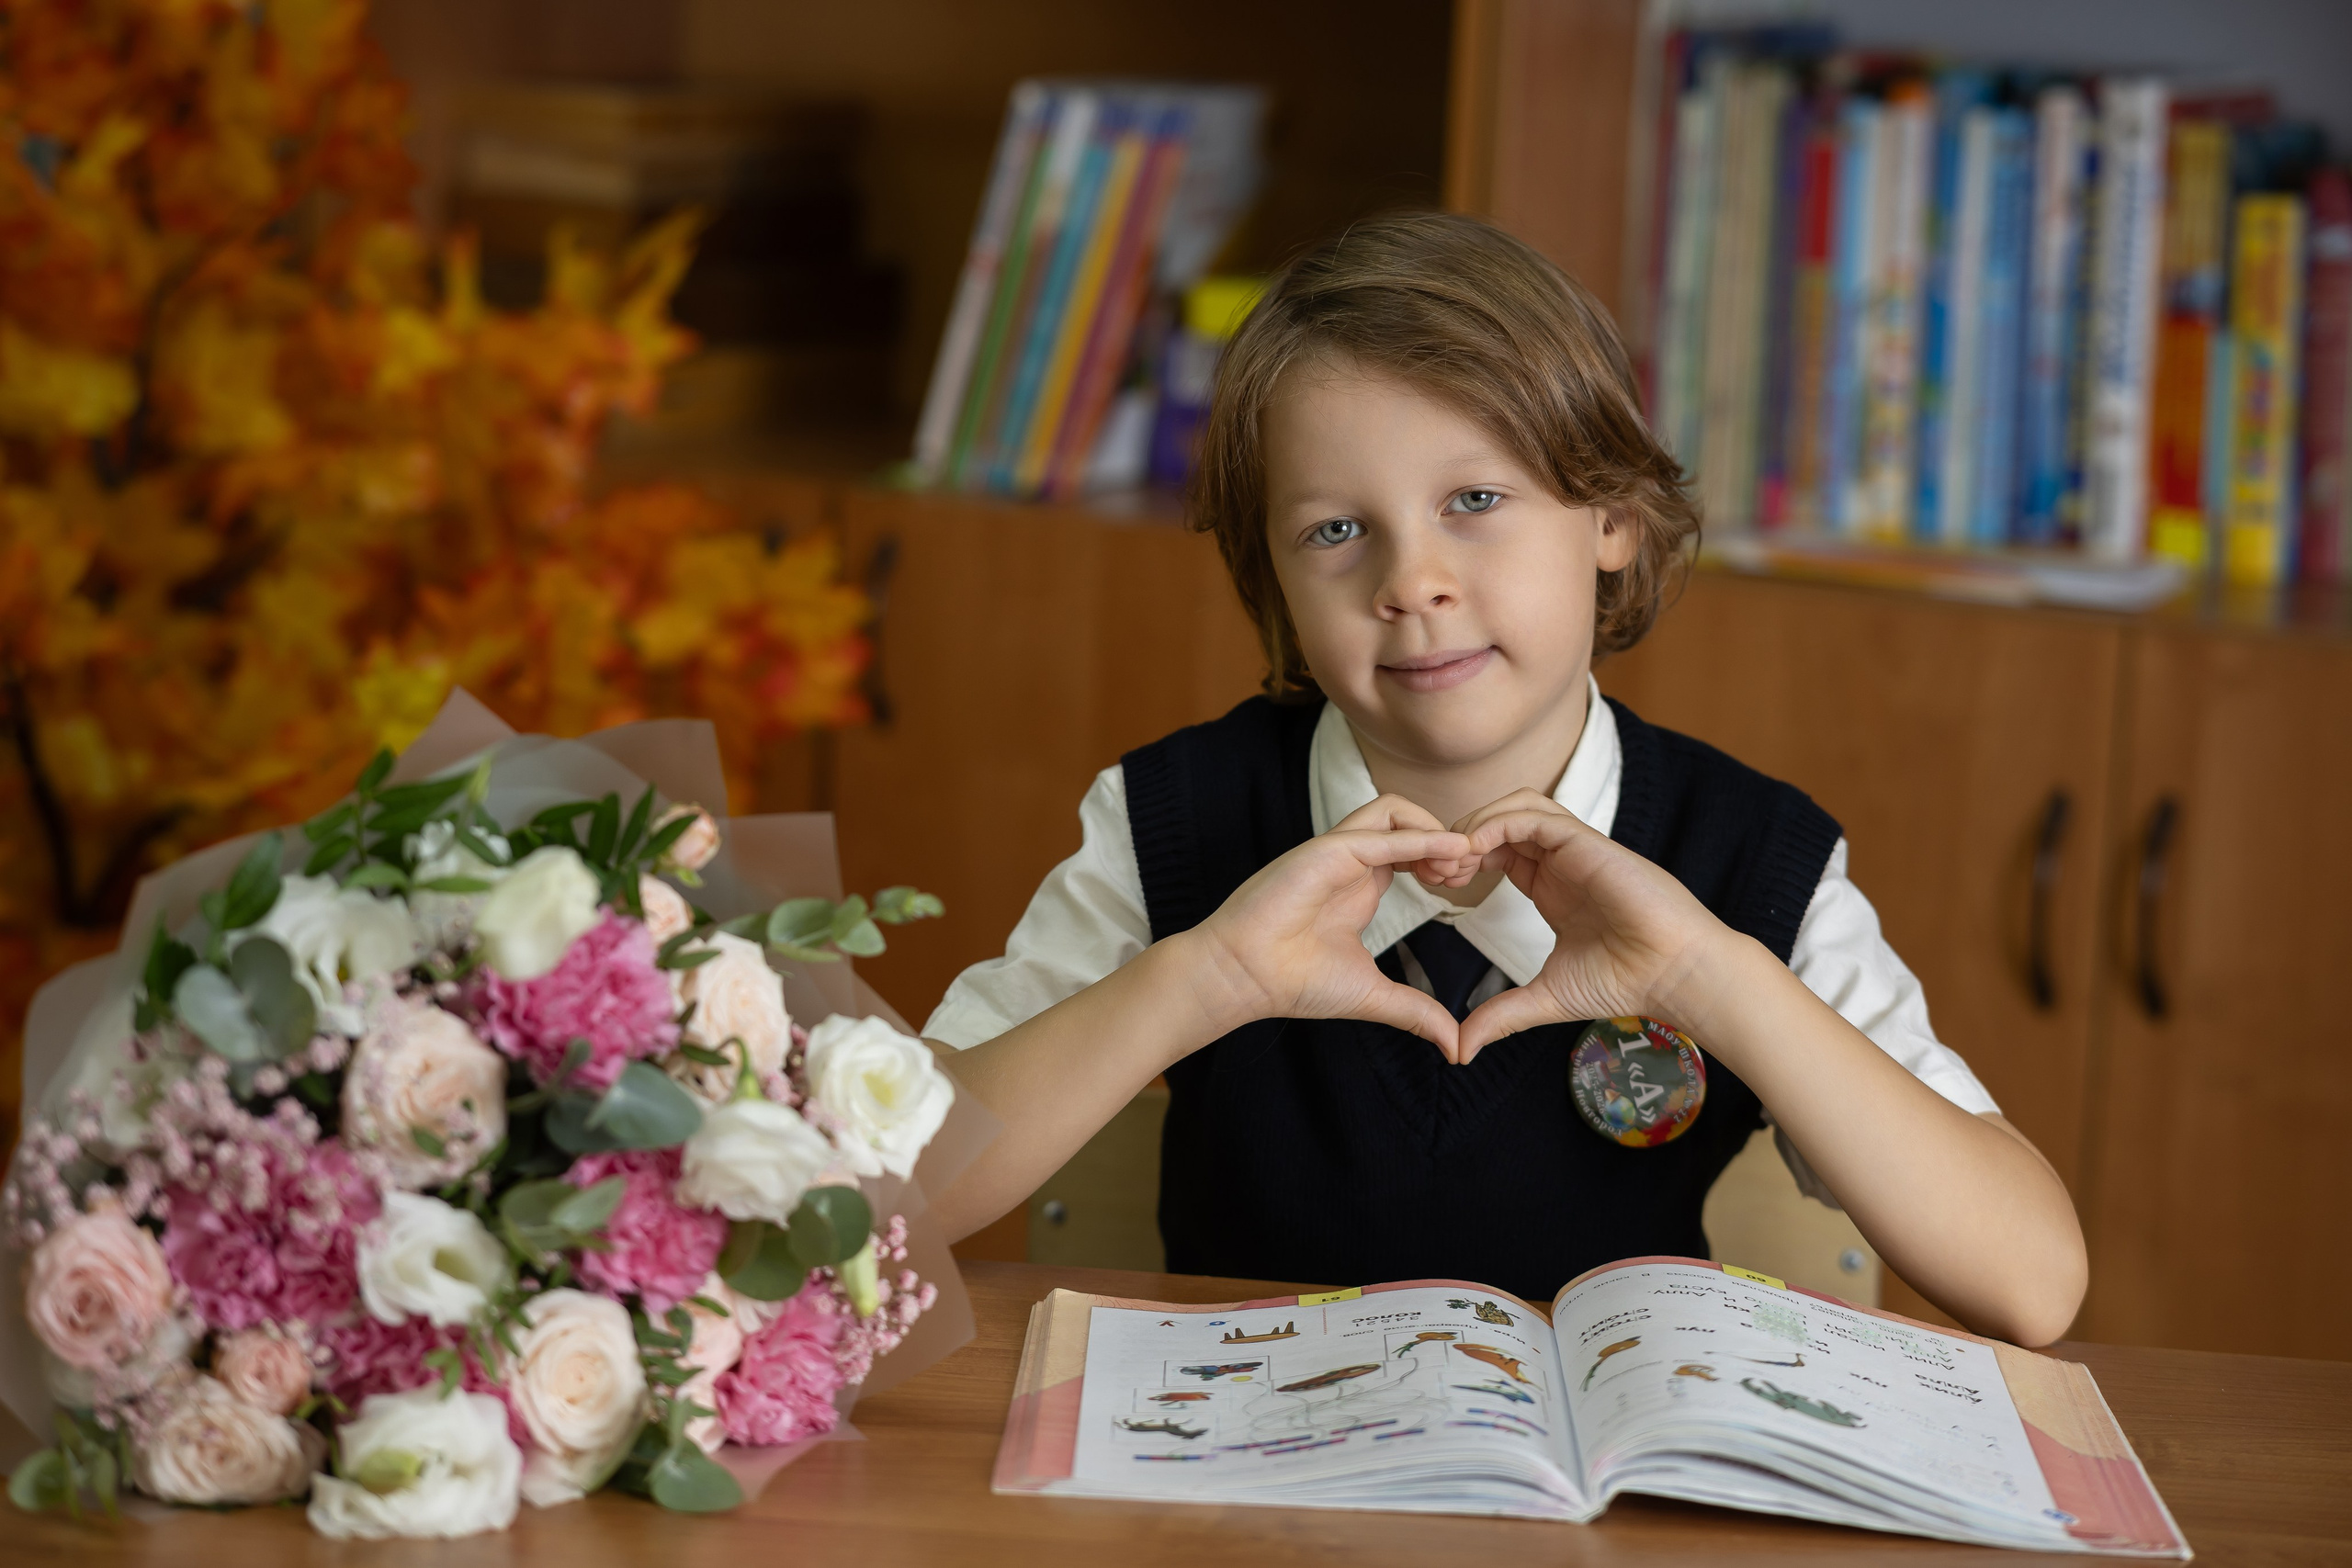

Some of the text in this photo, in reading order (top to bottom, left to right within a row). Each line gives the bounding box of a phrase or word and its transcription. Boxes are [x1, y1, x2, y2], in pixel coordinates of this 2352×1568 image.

[1618, 1032, 1651, 1058] 1
[1679, 1048, 1696, 1094] ШКОЛА
[1576, 1089, 1623, 1137] Новгород
[1745, 1274, 1767, 1282] 60
